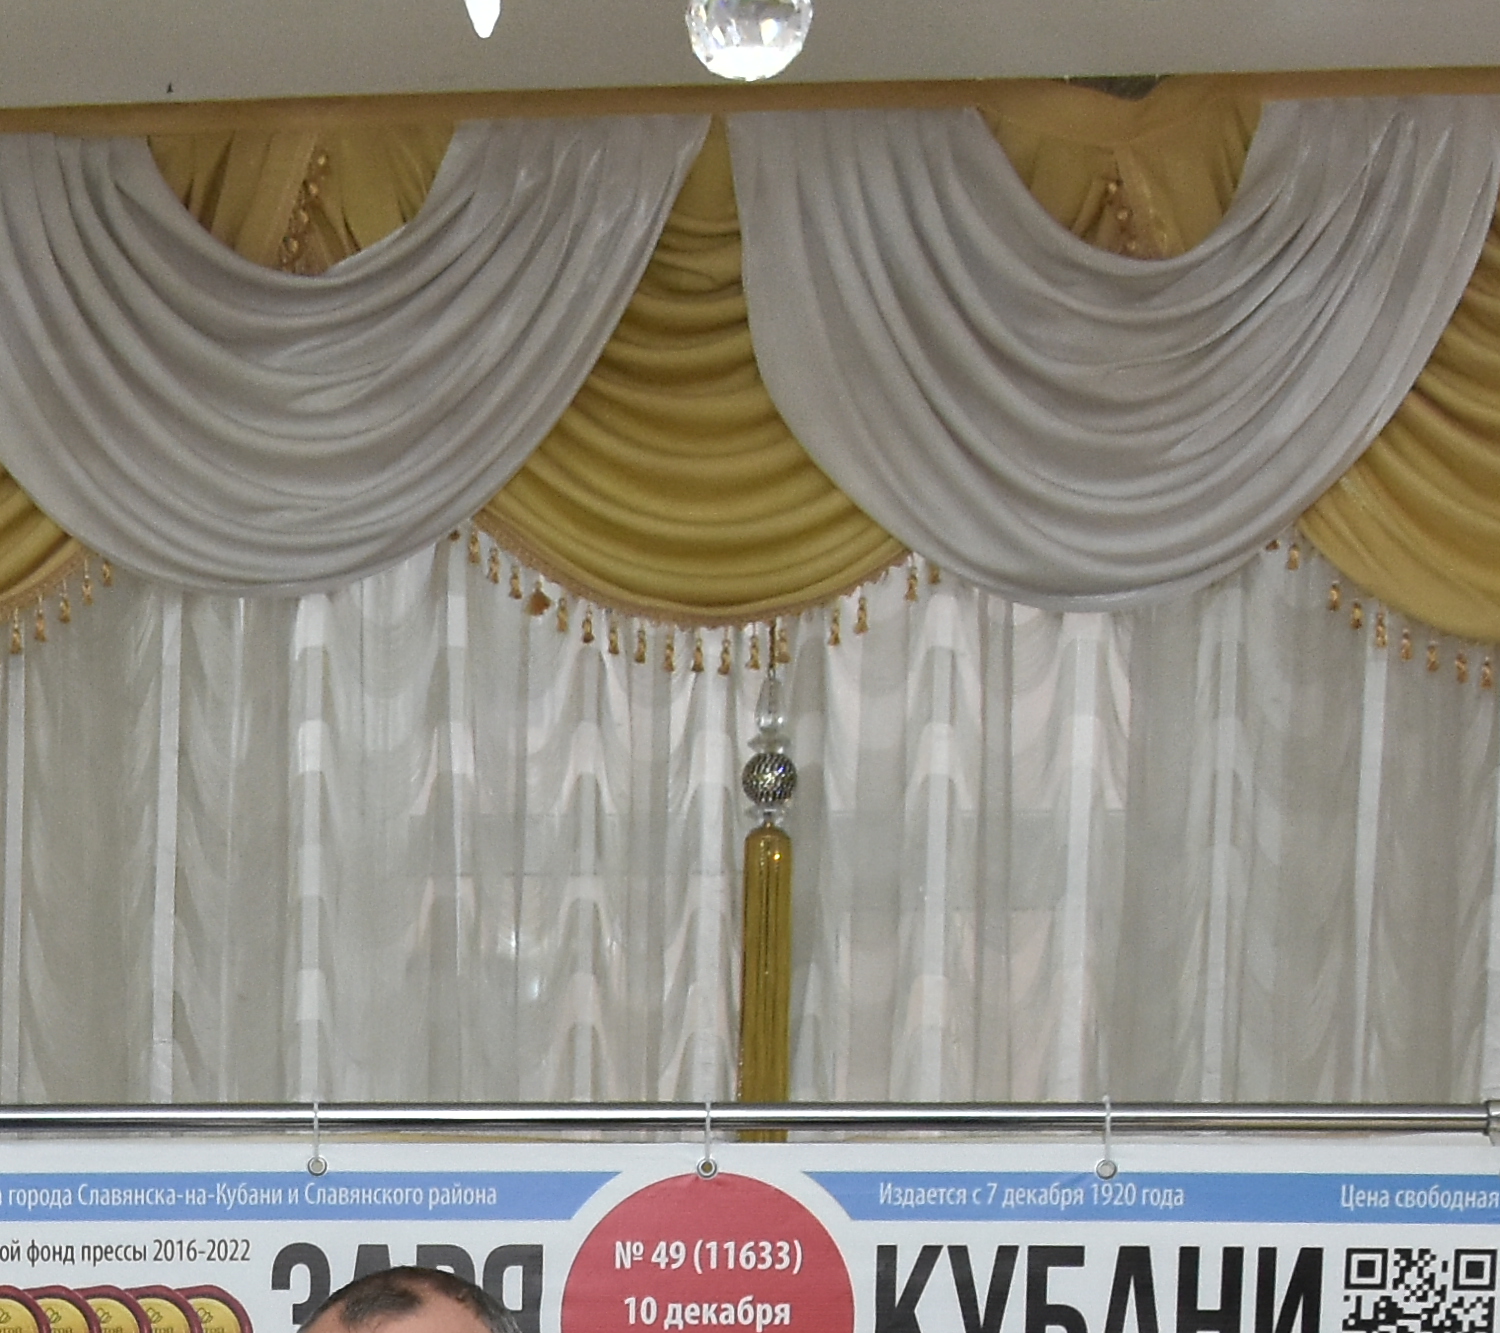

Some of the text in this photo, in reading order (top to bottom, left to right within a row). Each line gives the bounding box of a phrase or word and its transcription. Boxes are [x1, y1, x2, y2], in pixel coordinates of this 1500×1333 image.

[8, 1188, 72, 1211] города
[77, 1182, 282, 1210] Славянска-на-Кубани
[288, 1188, 298, 1204] и
[304, 1182, 423, 1205] Славянского
[428, 1182, 497, 1210] района
[879, 1181, 1184, 1211] Издается с 7 декабря 1920 года
[1340, 1184, 1500, 1212] Цена свободная
[26, 1238, 75, 1268] фонд
[81, 1244, 146, 1267] прессы
[152, 1238, 250, 1262] 2016-2022
[615, 1239, 802, 1274] № 49 (11633)
[624, 1294, 790, 1333] 10 декабря
